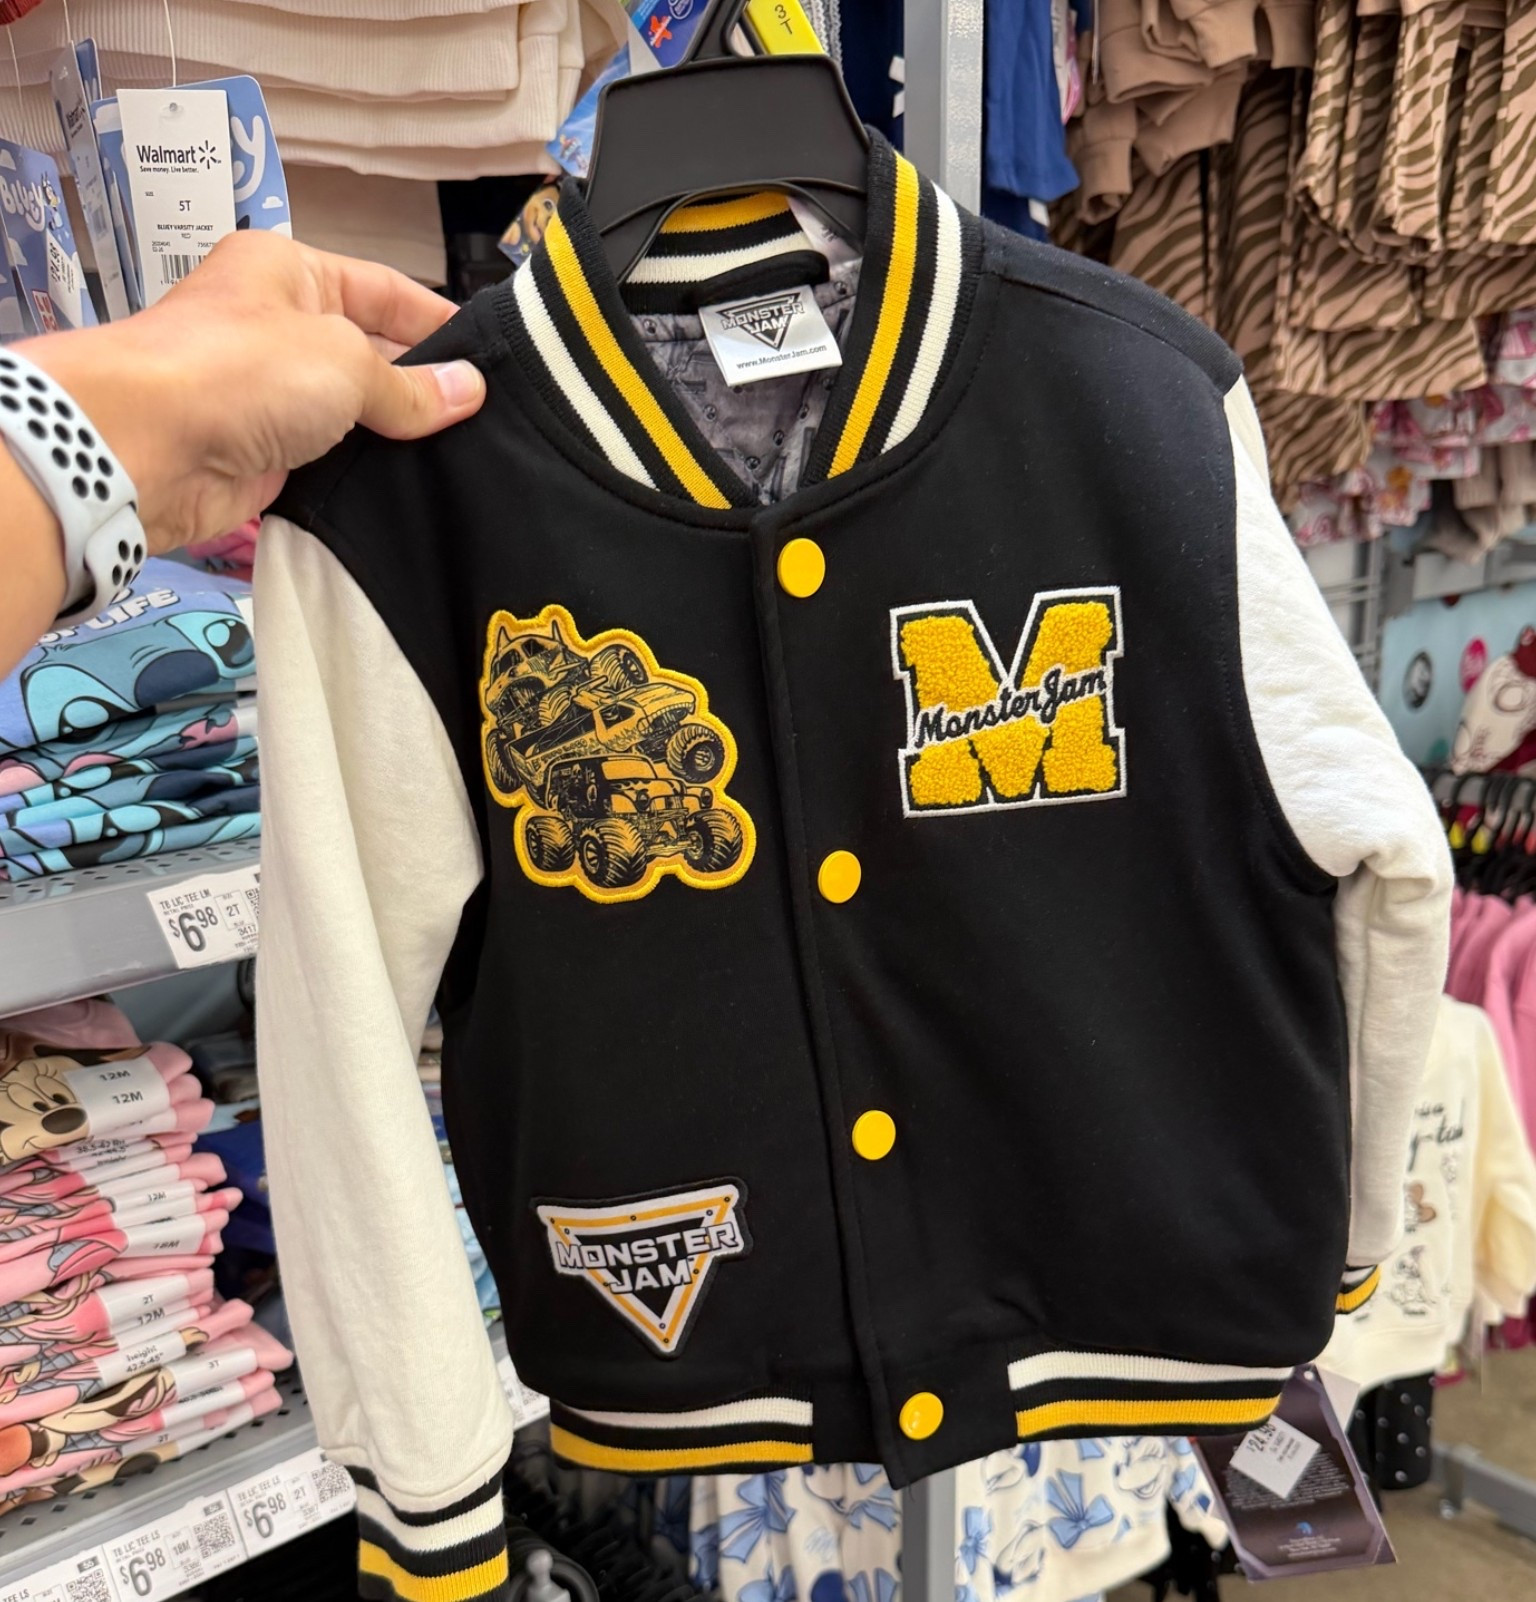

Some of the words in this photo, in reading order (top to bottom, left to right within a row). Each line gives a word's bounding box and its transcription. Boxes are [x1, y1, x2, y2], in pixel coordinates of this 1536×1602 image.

[136, 145, 197, 164] Walmart
[179, 200, 191, 211] 5T
[721, 301, 805, 330] MONSTER
[742, 315, 788, 334] JAM
[736, 344, 827, 370] www.MonsterJam.com
[84, 588, 181, 630] LIFE
[889, 586, 1127, 819] M
[914, 687, 1042, 748] Monster
[1040, 668, 1107, 724] Jam
[171, 896, 184, 907] LIC
[184, 892, 200, 903] TEE
[226, 904, 240, 917] 2T
[100, 1070, 130, 1081] 12M
[112, 1091, 143, 1105] 12M
[556, 1222, 739, 1269] MONSTER
[608, 1257, 693, 1294] JAM
[143, 1295, 154, 1305] 2T
[126, 1345, 157, 1362] height
[294, 1486, 306, 1500] 2T
[136, 1535, 150, 1547] TEE
[150, 1530, 161, 1540] LS
[172, 1540, 191, 1556] 18M
